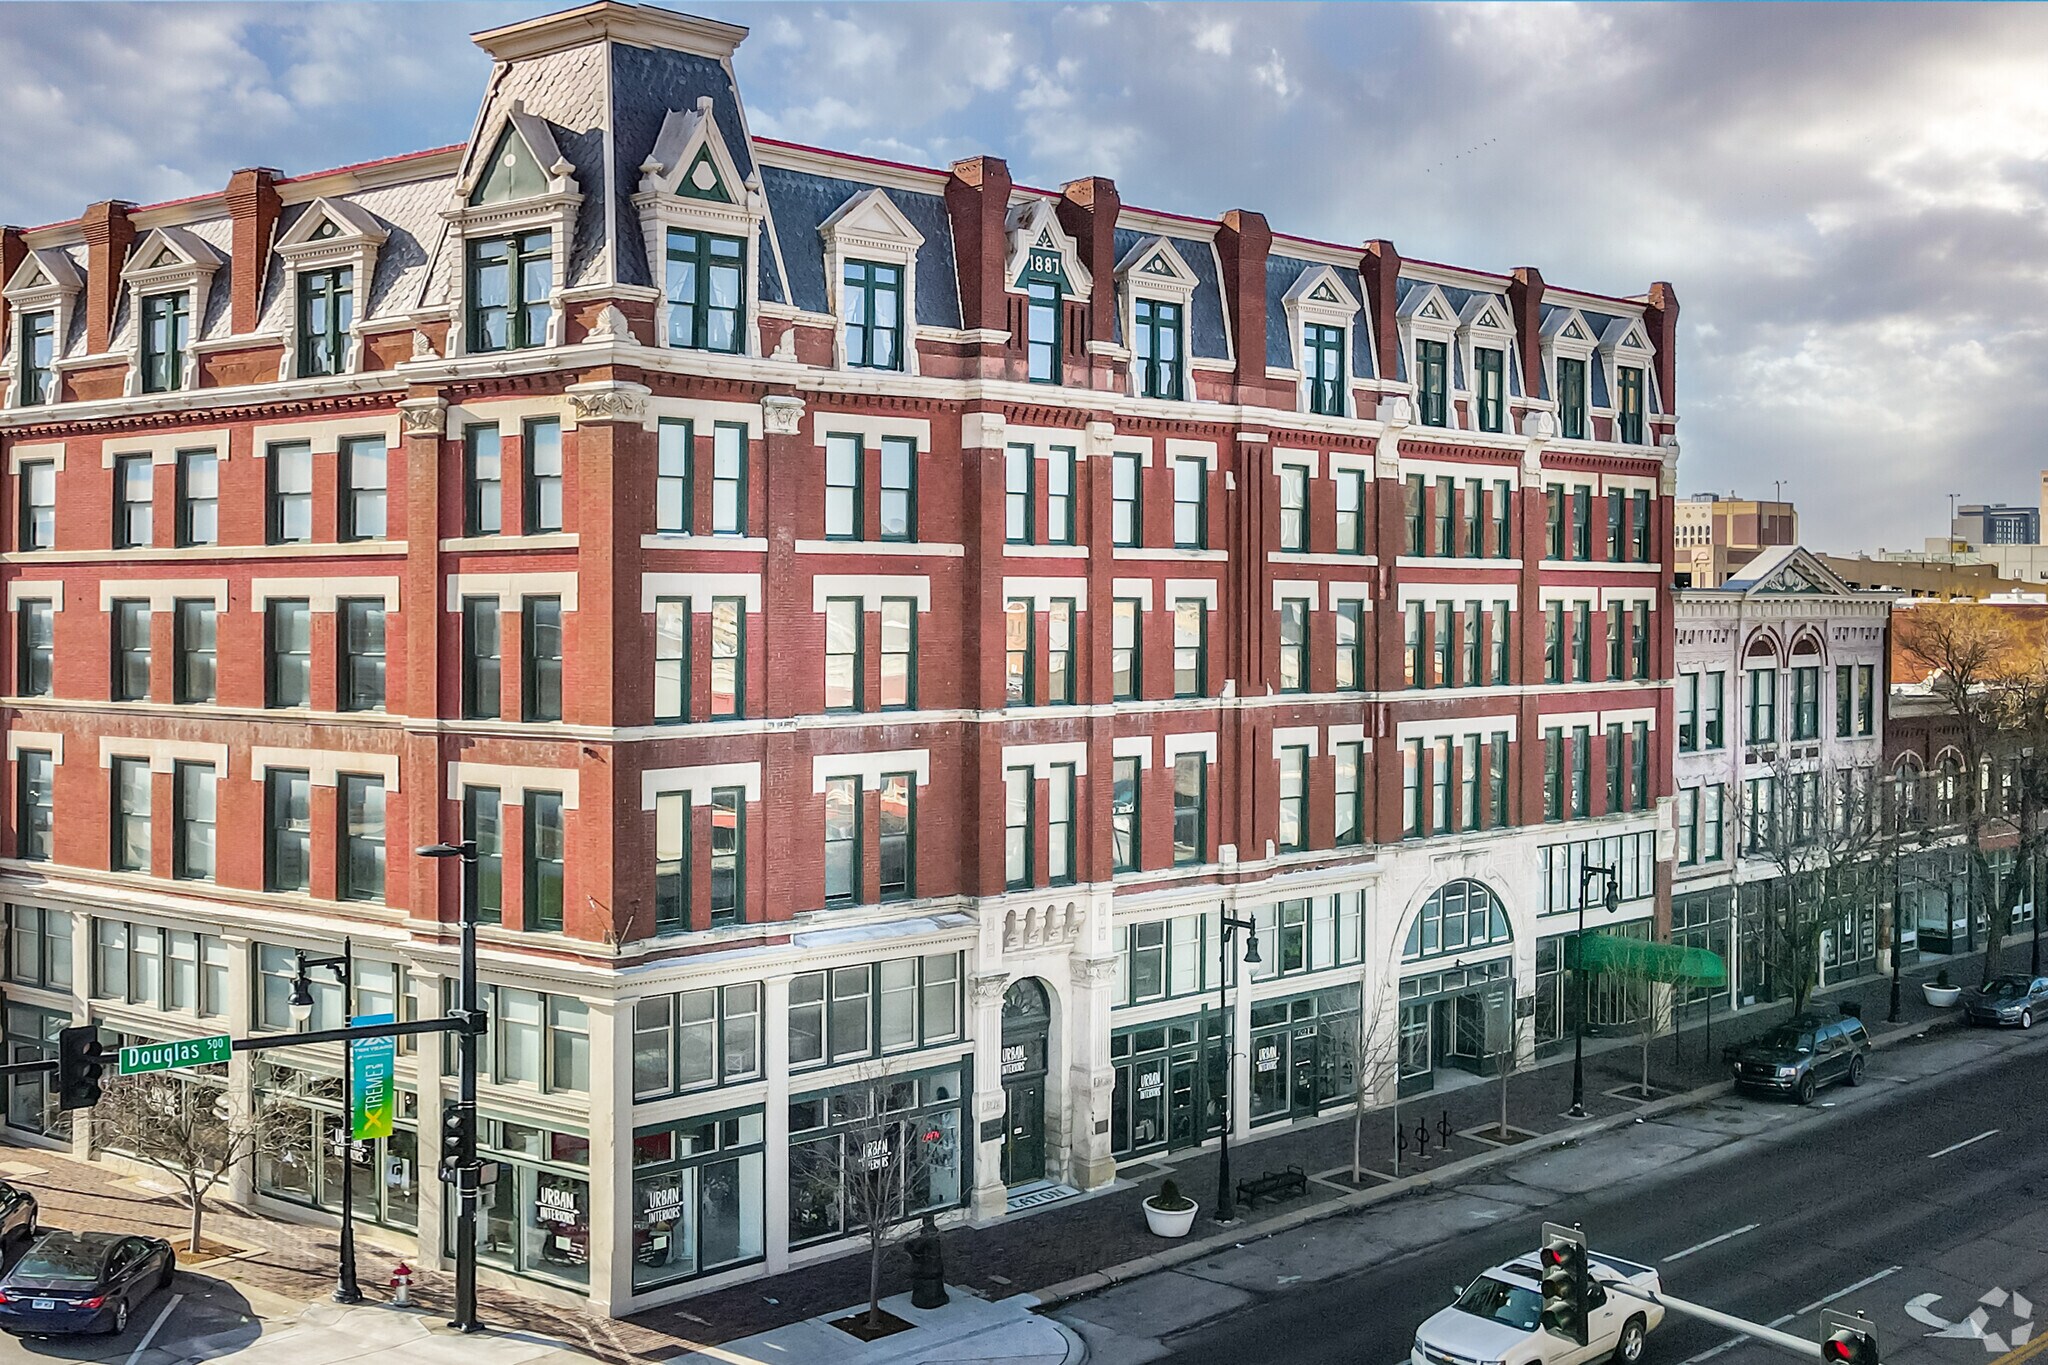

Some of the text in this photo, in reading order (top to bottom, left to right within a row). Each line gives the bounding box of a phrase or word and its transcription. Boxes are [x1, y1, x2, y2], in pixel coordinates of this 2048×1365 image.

[1029, 255, 1060, 275] 1887
[207, 1038, 223, 1050] 500
[1002, 1045, 1025, 1062] URBAN
[129, 1044, 199, 1067] Douglas
[213, 1050, 218, 1060] E
[1140, 1071, 1160, 1088] URBAN
[541, 1186, 574, 1210] URBAN
[649, 1186, 680, 1209] URBAN
[1007, 1188, 1068, 1208] EATON
[540, 1206, 576, 1226] INTERIORS
[648, 1206, 680, 1224] INTERIORS
